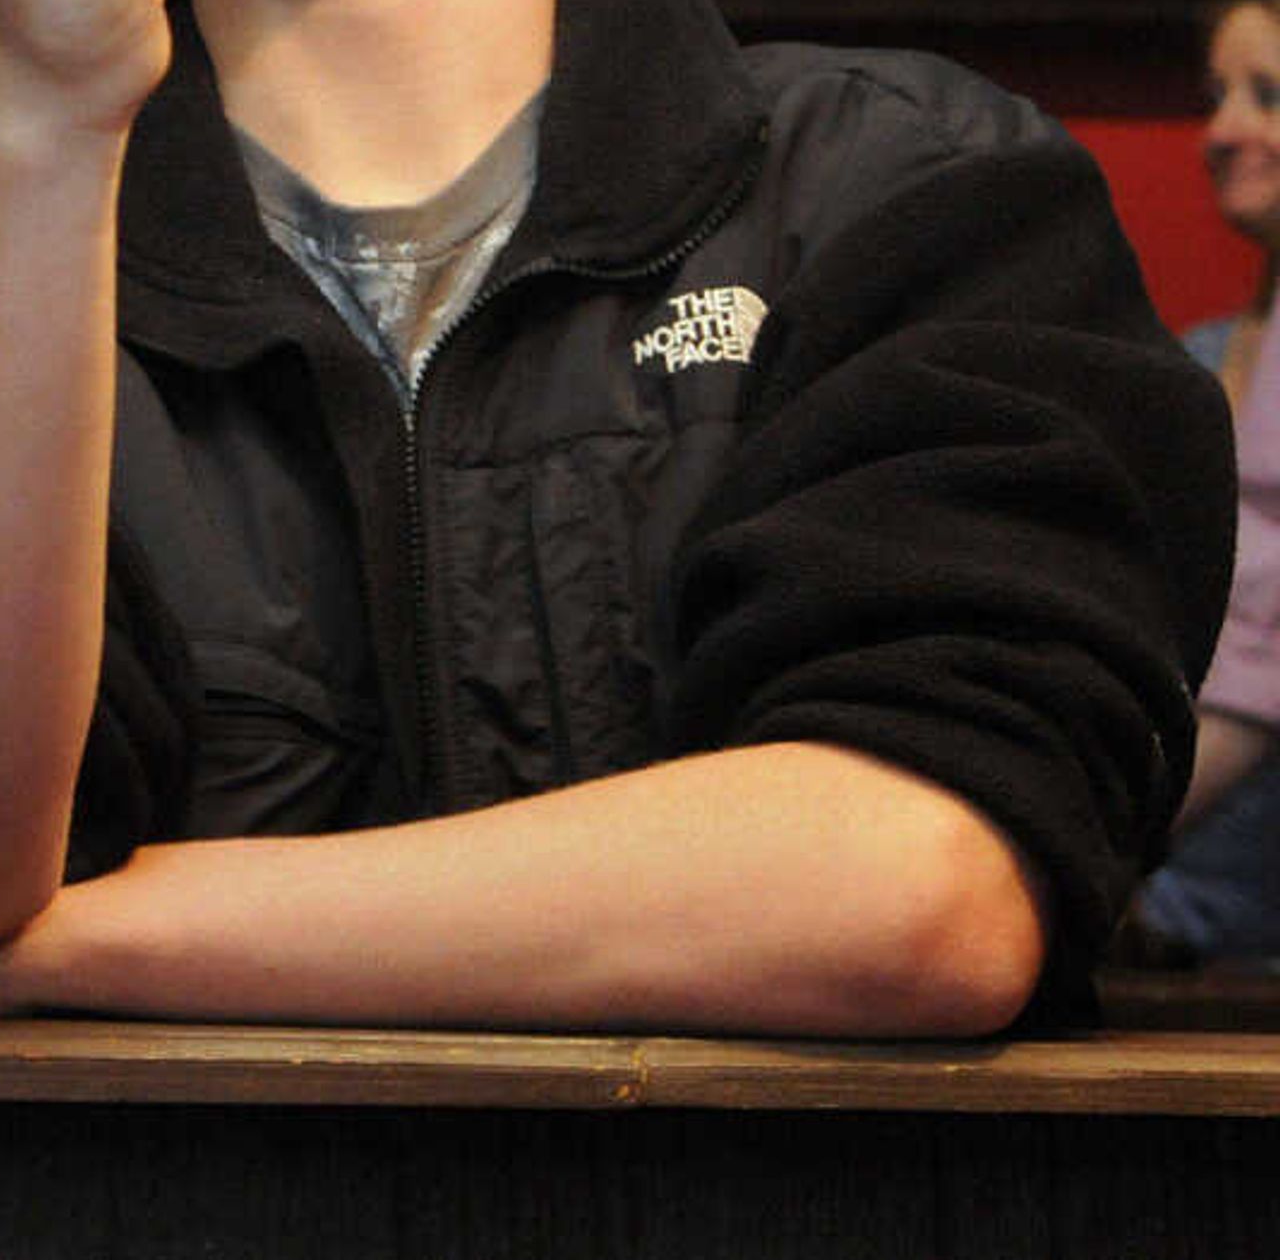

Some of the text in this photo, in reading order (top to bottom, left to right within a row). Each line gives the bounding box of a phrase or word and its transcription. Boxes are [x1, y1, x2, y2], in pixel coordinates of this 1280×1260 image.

[668, 288, 734, 319] THE
[633, 312, 735, 365] NORTH
[666, 337, 744, 373] FACE
